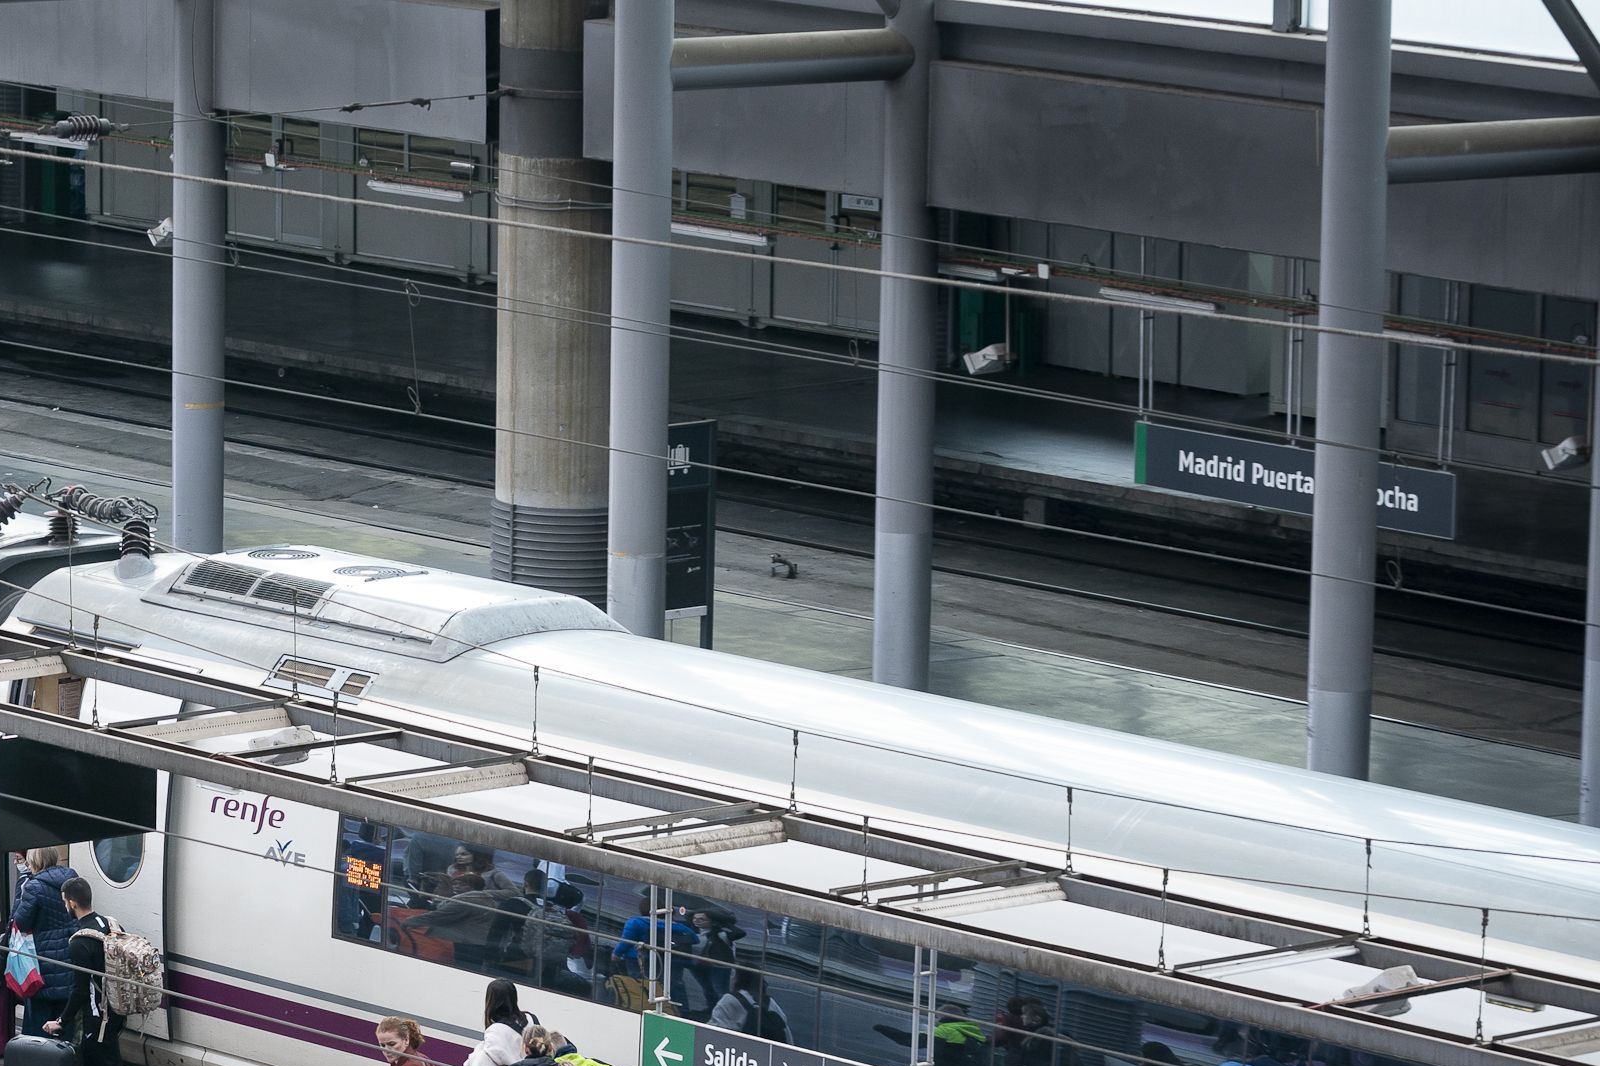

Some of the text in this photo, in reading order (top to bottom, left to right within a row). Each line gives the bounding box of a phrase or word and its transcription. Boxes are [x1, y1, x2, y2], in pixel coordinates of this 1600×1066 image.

[1178, 450, 1245, 483] Madrid
[1251, 463, 1314, 495] Puerta
[210, 794, 285, 835] renfe
[264, 840, 306, 868] AVE
